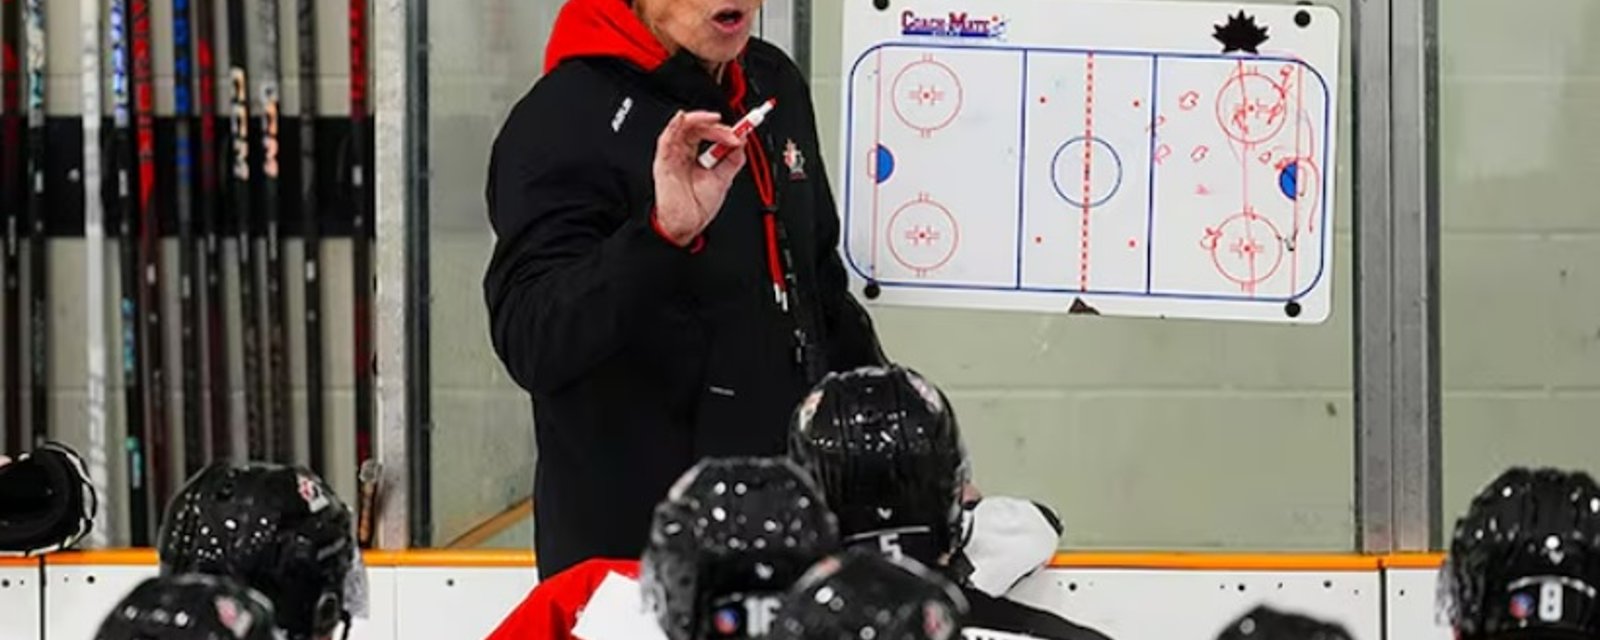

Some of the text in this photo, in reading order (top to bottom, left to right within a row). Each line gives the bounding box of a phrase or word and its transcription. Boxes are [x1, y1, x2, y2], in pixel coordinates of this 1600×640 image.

[230, 67, 250, 181] CCM
[879, 532, 903, 561] 5
[1539, 580, 1563, 622] 8
